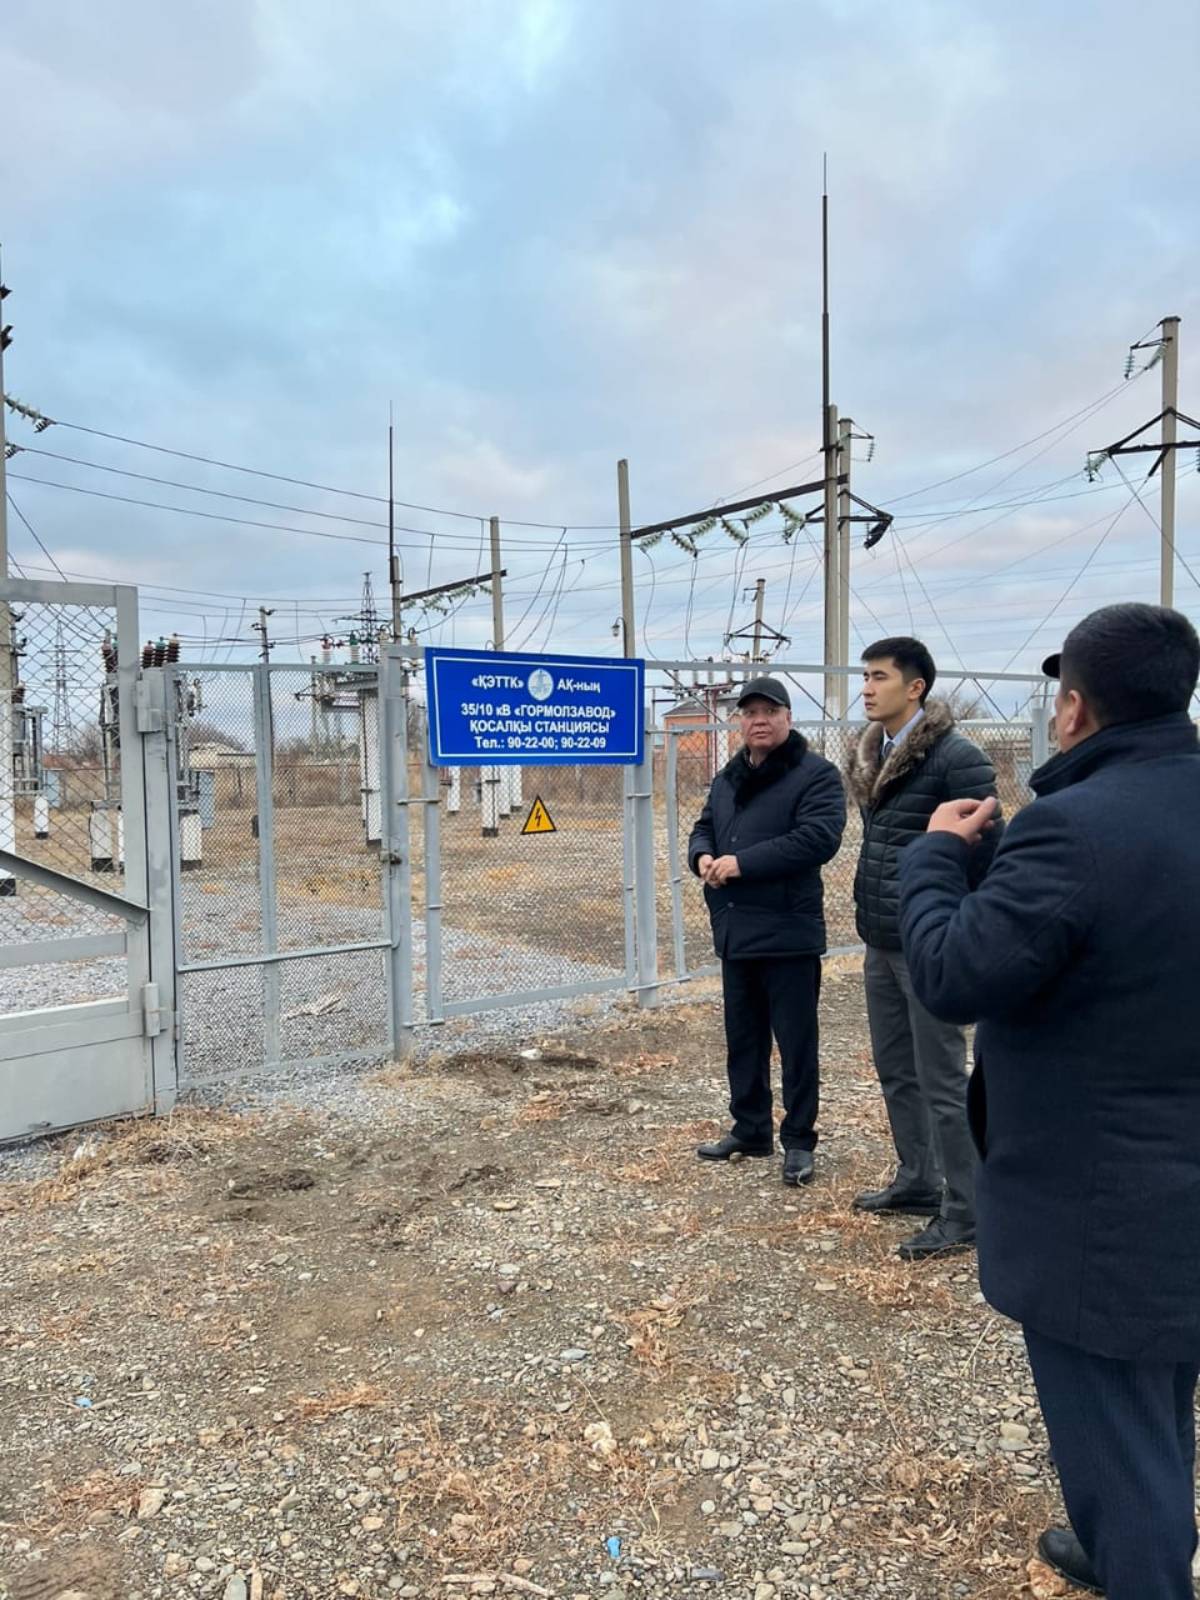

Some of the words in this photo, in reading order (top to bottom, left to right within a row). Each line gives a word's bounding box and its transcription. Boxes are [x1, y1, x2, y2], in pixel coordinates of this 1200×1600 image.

[460, 703, 492, 716] 35/10
[496, 705, 511, 717] кВ
[514, 704, 616, 719] «ГОРМОЛЗАВОД»
[470, 719, 532, 735] ҚОСАЛҚЫ
[535, 720, 609, 735] СТАНЦИЯСЫ
[474, 736, 505, 749] Тел.:
[507, 736, 558, 749] 90-22-00;
[560, 736, 607, 749] 90-22-09
